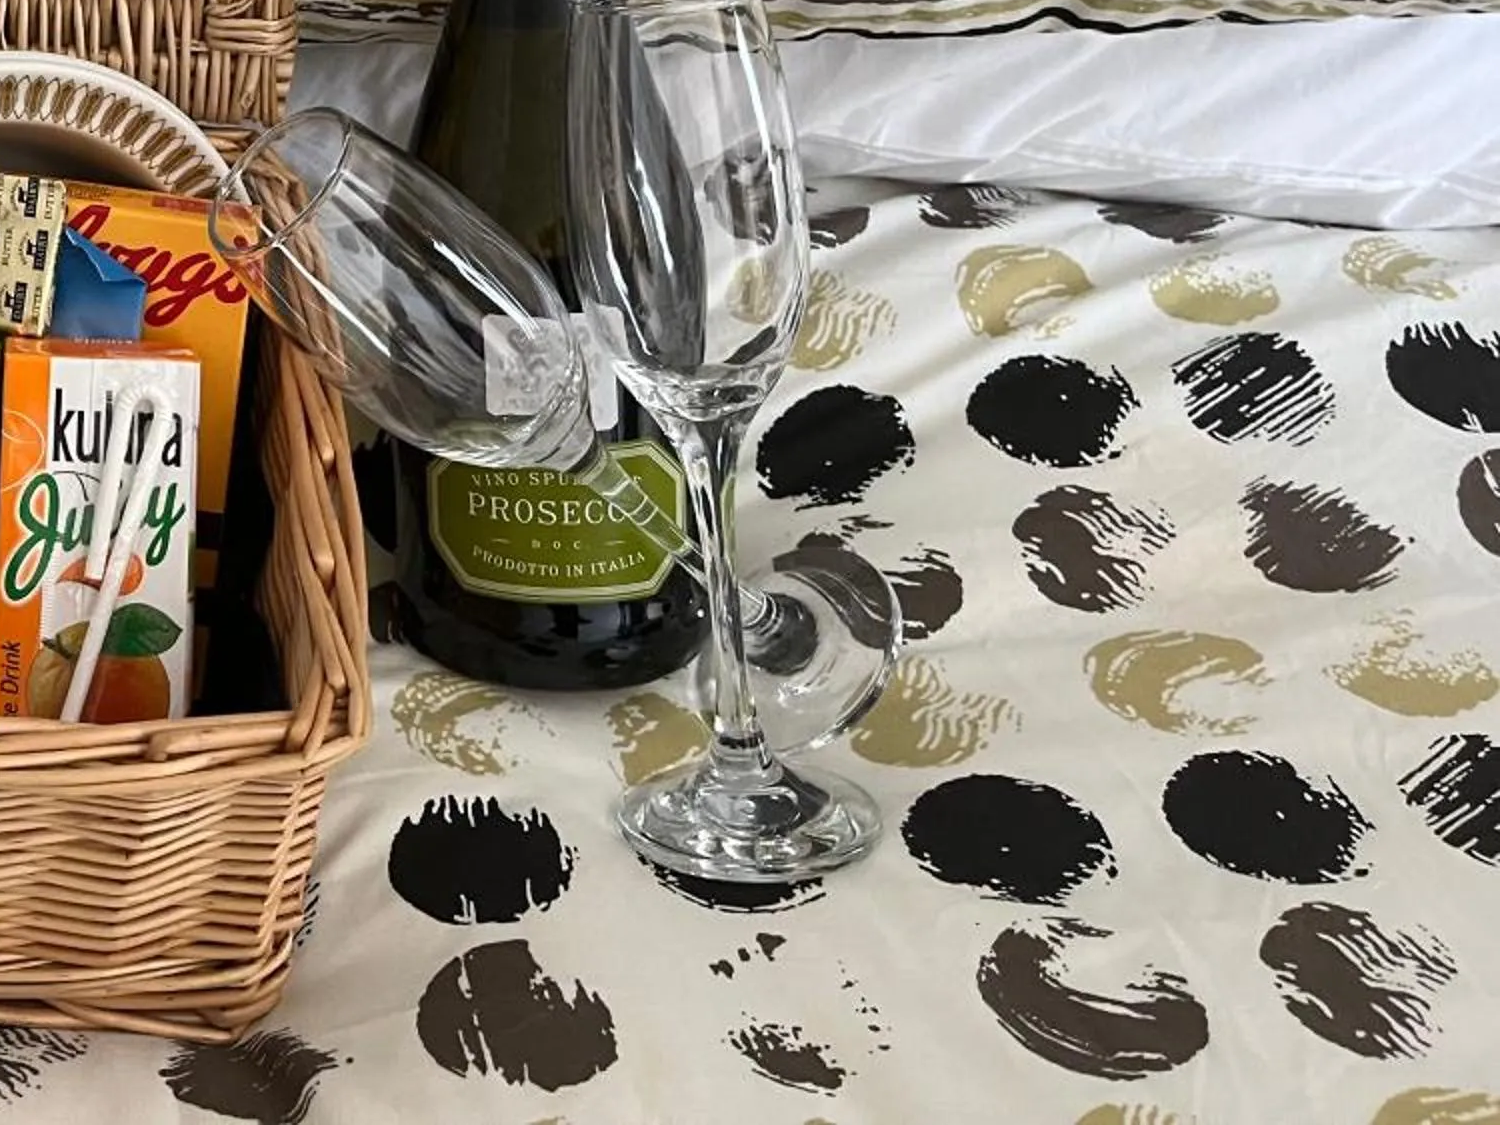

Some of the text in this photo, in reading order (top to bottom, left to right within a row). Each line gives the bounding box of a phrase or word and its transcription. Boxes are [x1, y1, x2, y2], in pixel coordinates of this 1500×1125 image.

[471, 472, 520, 487] VINO
[467, 491, 627, 526] PROSECC
[3, 472, 186, 601] Juy
[472, 544, 647, 579] PRODOTTO IN ITALIA
[1, 640, 22, 695] Drink
